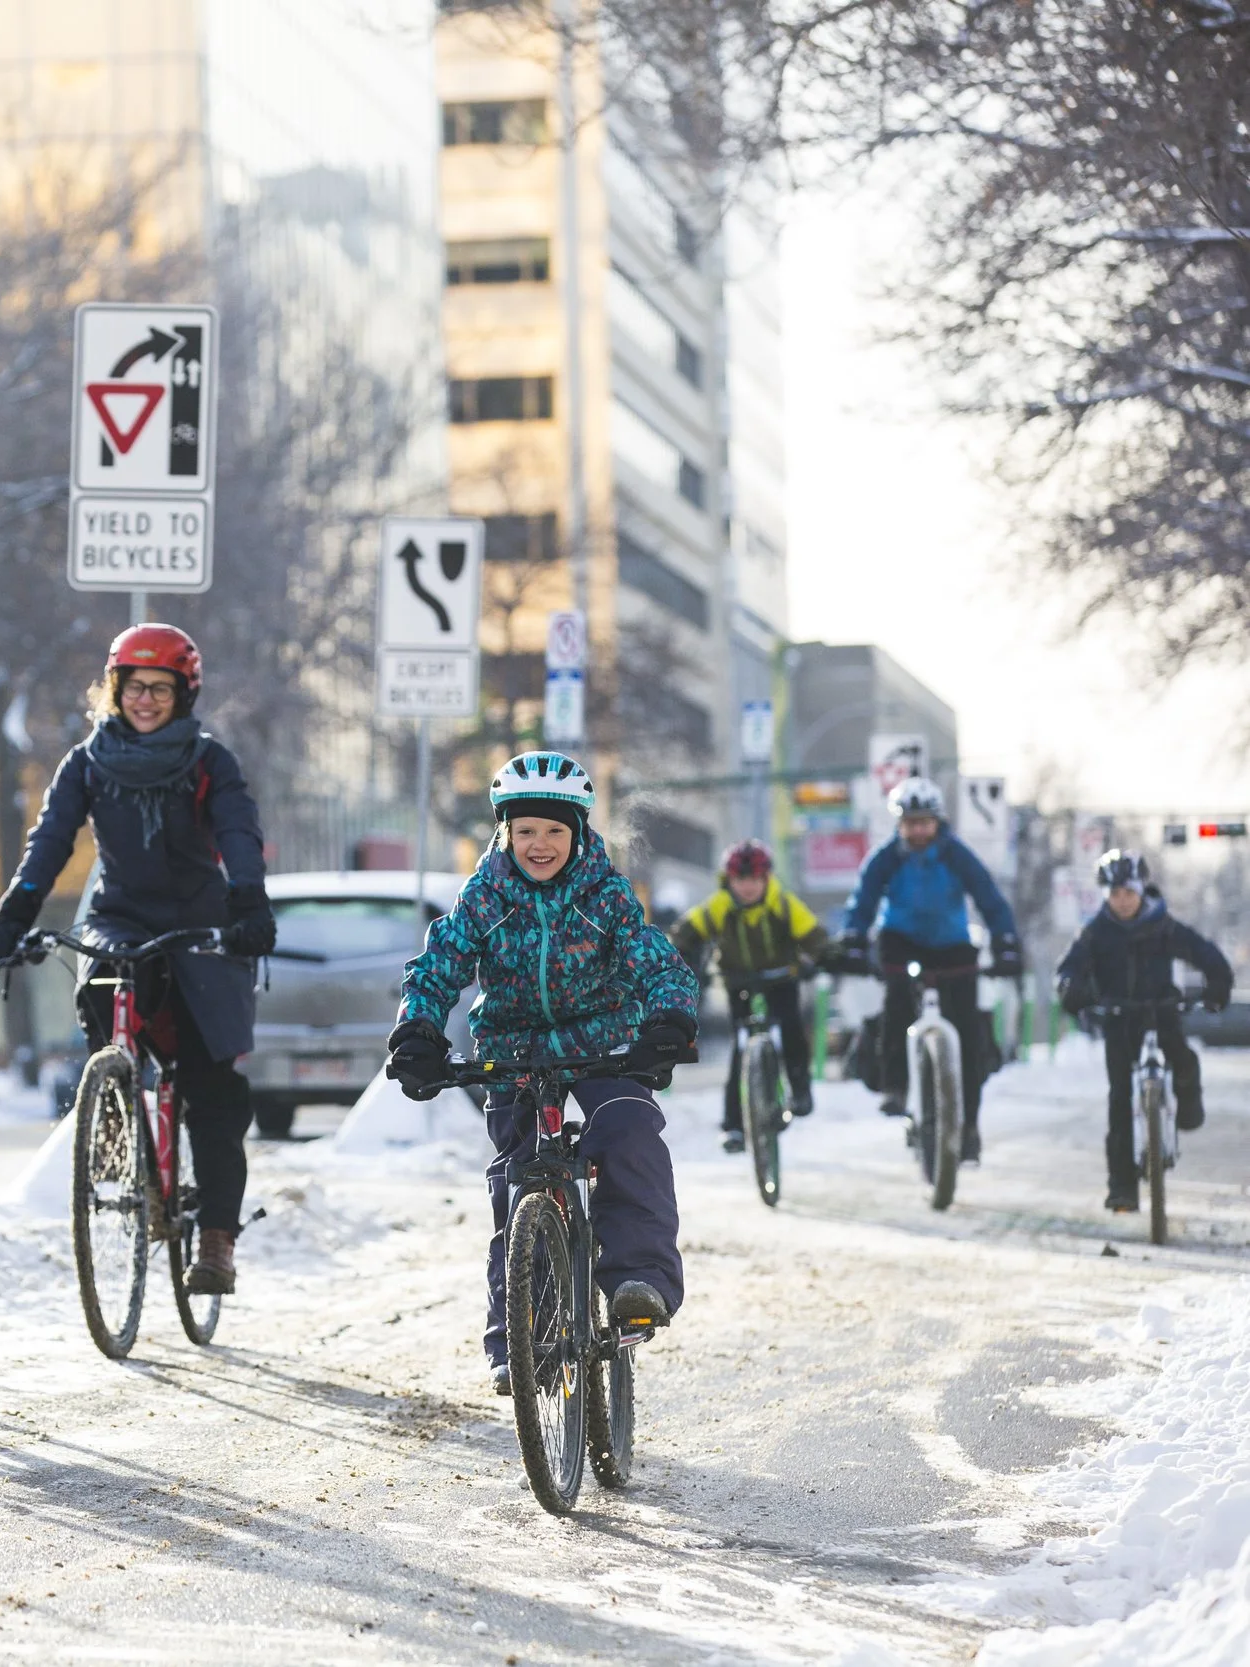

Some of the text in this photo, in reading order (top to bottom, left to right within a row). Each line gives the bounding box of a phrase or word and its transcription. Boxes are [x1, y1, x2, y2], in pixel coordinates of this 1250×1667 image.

[83, 511, 200, 536] YIELD TO
[82, 544, 198, 571] BICYCLES
